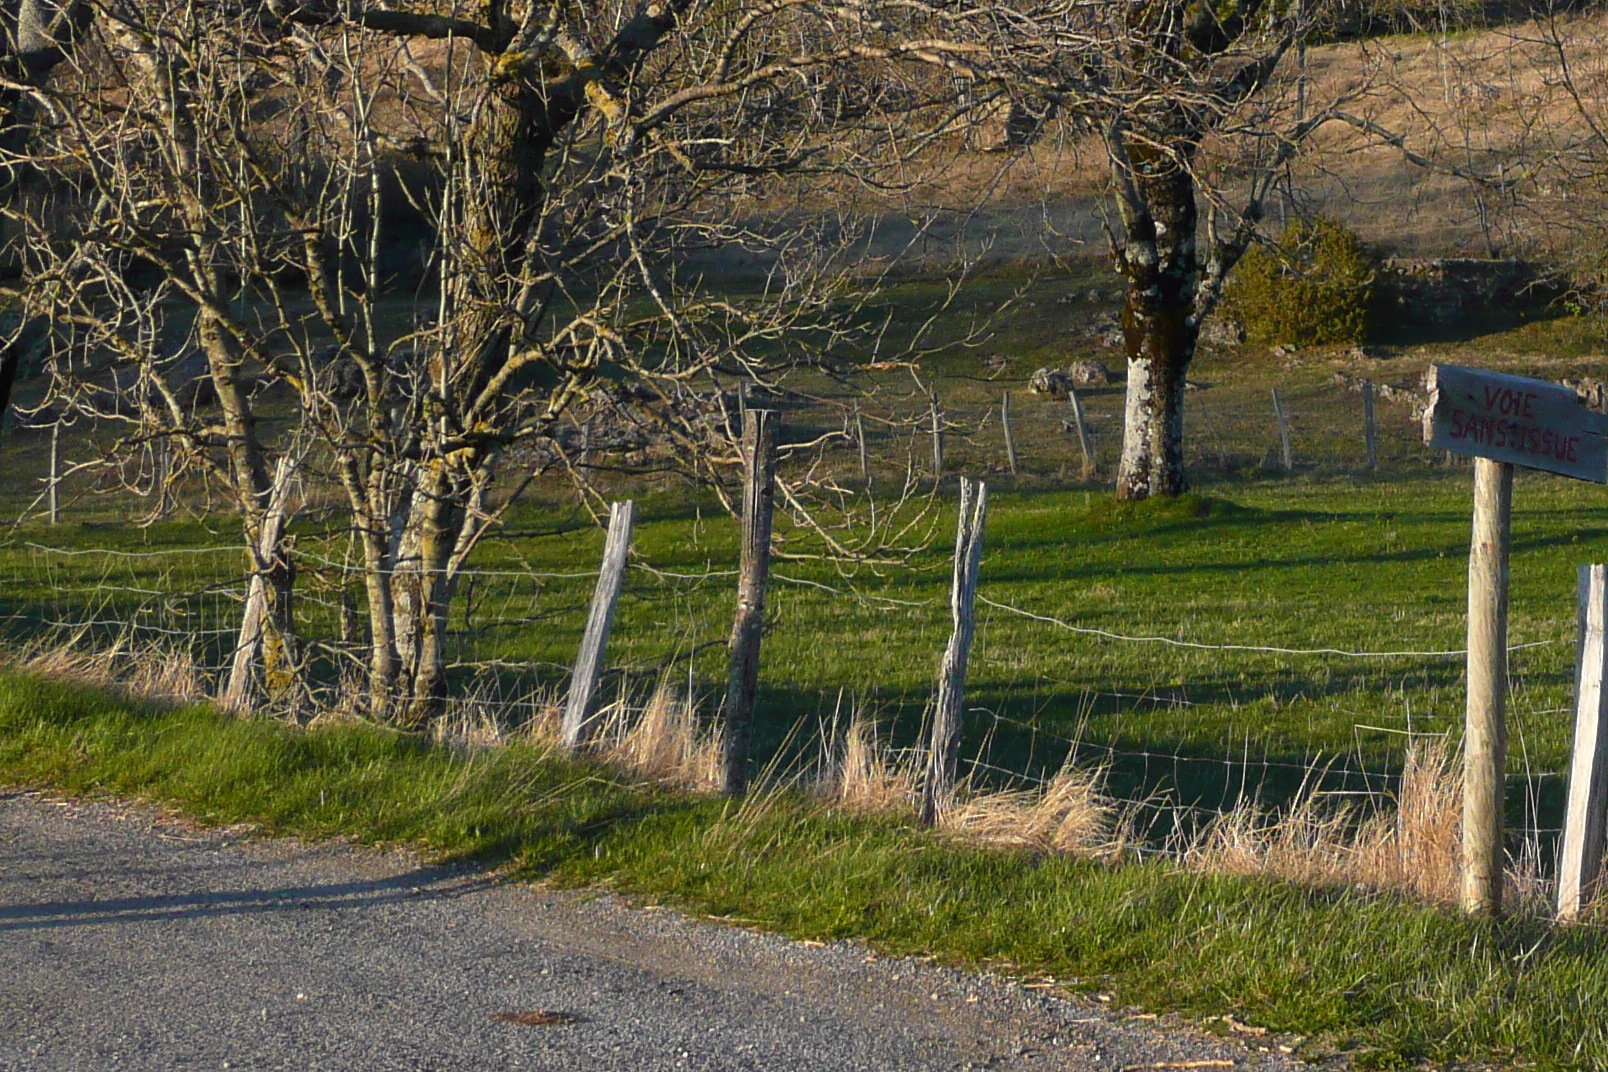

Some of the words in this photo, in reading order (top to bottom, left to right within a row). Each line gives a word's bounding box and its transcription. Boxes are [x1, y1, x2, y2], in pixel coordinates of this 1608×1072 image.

[1484, 385, 1537, 418] VOIE
[1449, 409, 1508, 447] SANS
[1514, 425, 1581, 463] ISSUE
